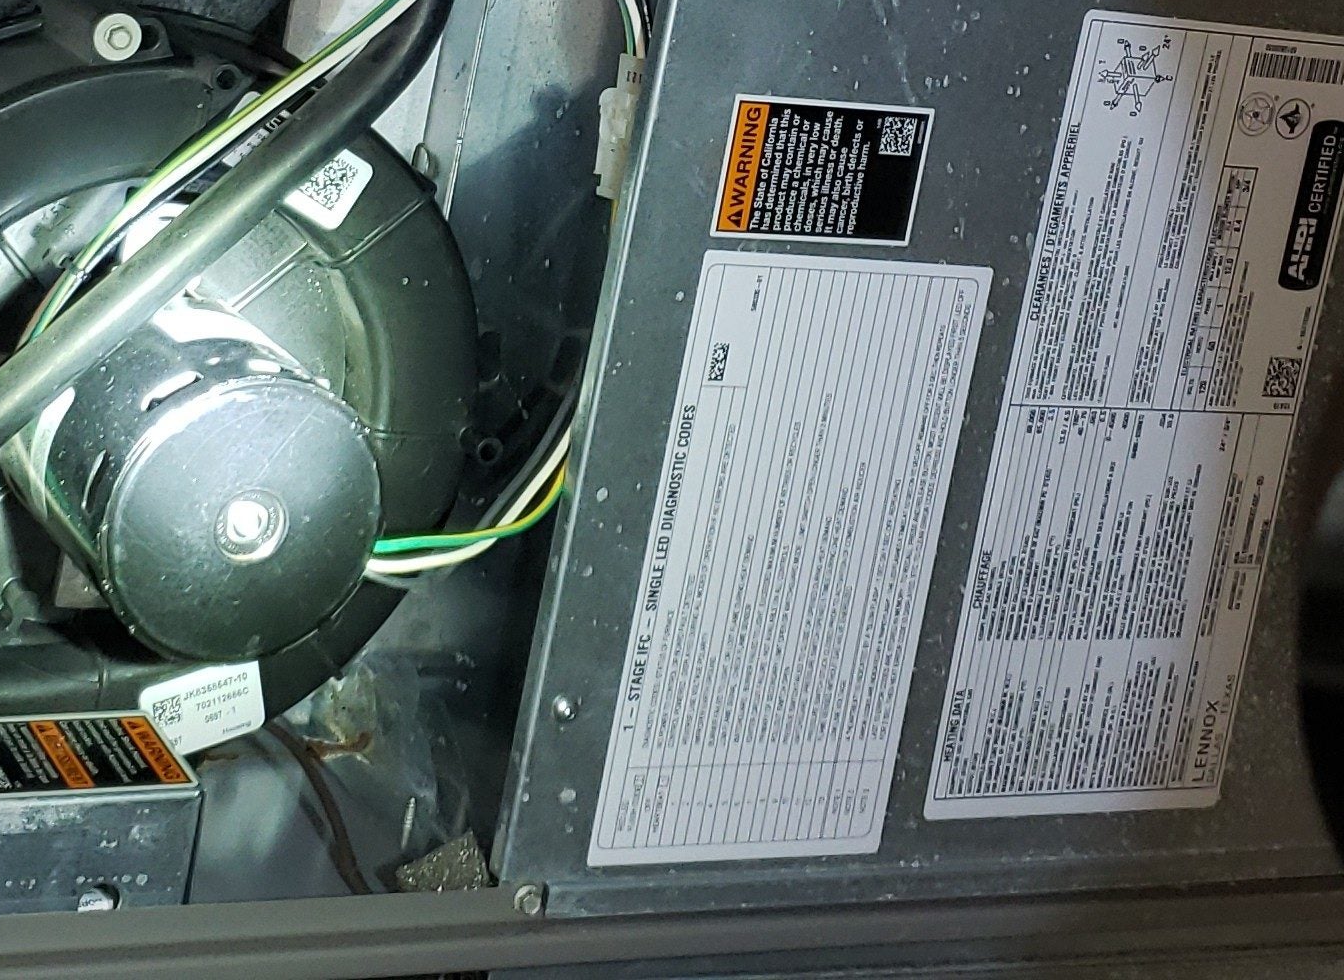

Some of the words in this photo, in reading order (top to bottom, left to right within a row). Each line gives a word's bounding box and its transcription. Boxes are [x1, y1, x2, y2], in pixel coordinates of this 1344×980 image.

[780, 108, 792, 126] this
[792, 114, 801, 125] or
[810, 122, 821, 140] low
[821, 110, 834, 141] cause
[830, 115, 844, 146] death.
[856, 119, 865, 130] or
[761, 117, 779, 166] California
[775, 128, 788, 149] that
[783, 127, 799, 165] contain
[807, 142, 819, 164] very
[817, 143, 830, 164] may
[829, 149, 838, 159] or
[846, 132, 862, 169] defects
[729, 106, 762, 207] WARNING
[803, 166, 813, 175] in
[836, 146, 849, 177] cause
[758, 168, 769, 178] of
[764, 152, 783, 209] determined
[780, 167, 793, 189] may
[782, 189, 799, 231] produce
[792, 132, 809, 178] chemical
[802, 119, 811, 130] or
[810, 167, 824, 196] which
[821, 161, 835, 193] illness
[841, 171, 854, 195] birth
[845, 171, 866, 234] reproductive
[858, 140, 871, 169] harm.
[1307, 134, 1337, 213] CERTIFIED
[753, 181, 767, 208] State
[792, 178, 811, 231] chemicals,
[830, 179, 843, 200] also
[749, 210, 762, 229] The
[760, 211, 772, 230] has
[771, 191, 788, 230] product
[803, 198, 818, 232] doses,
[813, 196, 828, 232] serious
[827, 201, 840, 223] may
[835, 197, 850, 233] cancer,
[1285, 216, 1318, 280] AHRI
[1029, 255, 1052, 321] CLEARANCES
[676, 403, 696, 447] CODES
[660, 451, 687, 530] DIAGNOSTIC
[654, 535, 670, 559] LED
[644, 564, 665, 611] SINGLE
[971, 549, 993, 608] CHAUFFAGE
[636, 634, 651, 654] IFC
[628, 659, 646, 700] STAGE
[942, 720, 959, 761] HEATING
[951, 689, 965, 715] DATA
[1190, 699, 1220, 781] LENNOX
[133, 730, 182, 780] WARNING
